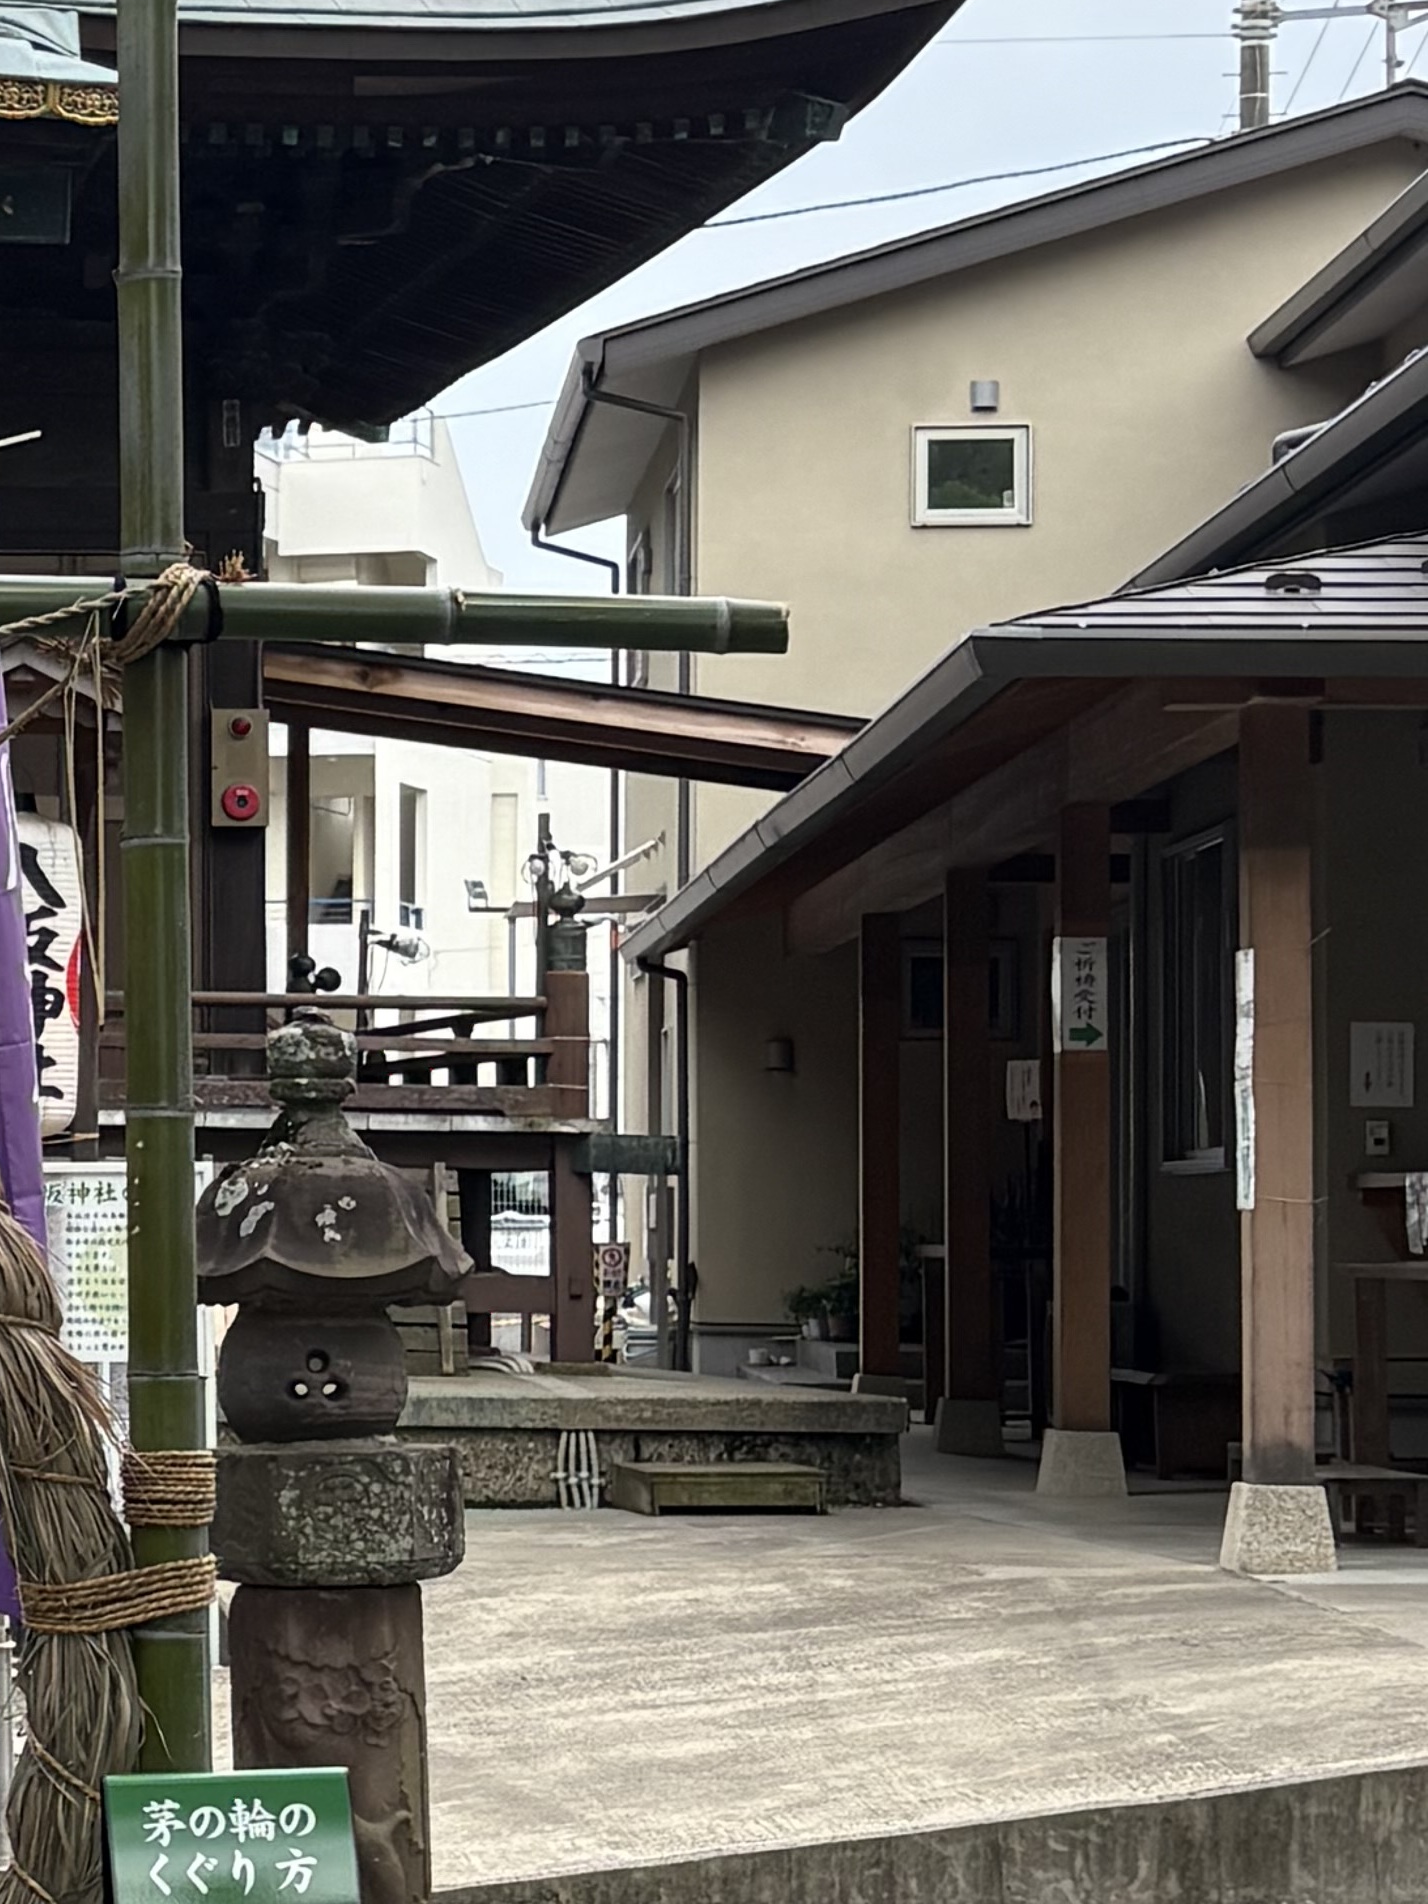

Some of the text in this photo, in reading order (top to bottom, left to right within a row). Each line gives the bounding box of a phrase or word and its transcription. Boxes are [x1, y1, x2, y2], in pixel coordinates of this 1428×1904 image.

[142, 1798, 317, 1846] 茅の輪の
[149, 1848, 318, 1896] くぐり方
